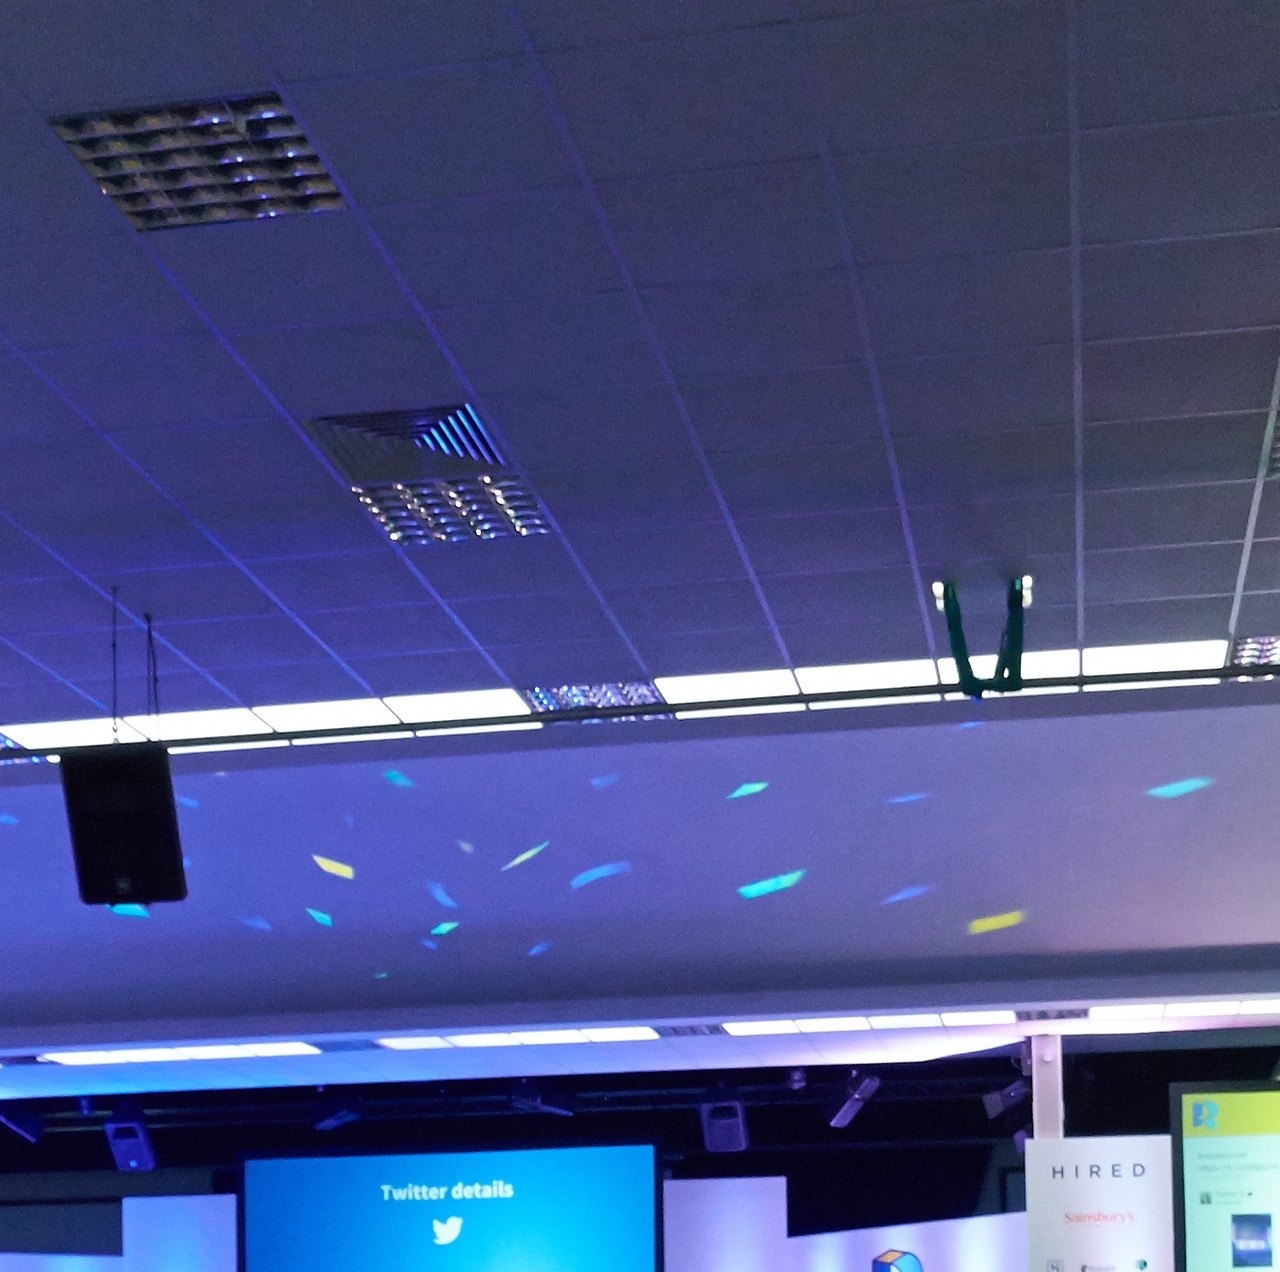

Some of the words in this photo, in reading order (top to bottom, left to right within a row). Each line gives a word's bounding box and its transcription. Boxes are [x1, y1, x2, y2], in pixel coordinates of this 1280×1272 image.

[1051, 1162, 1147, 1180] HIRED
[380, 1183, 448, 1201] Twitter
[450, 1179, 515, 1200] details
